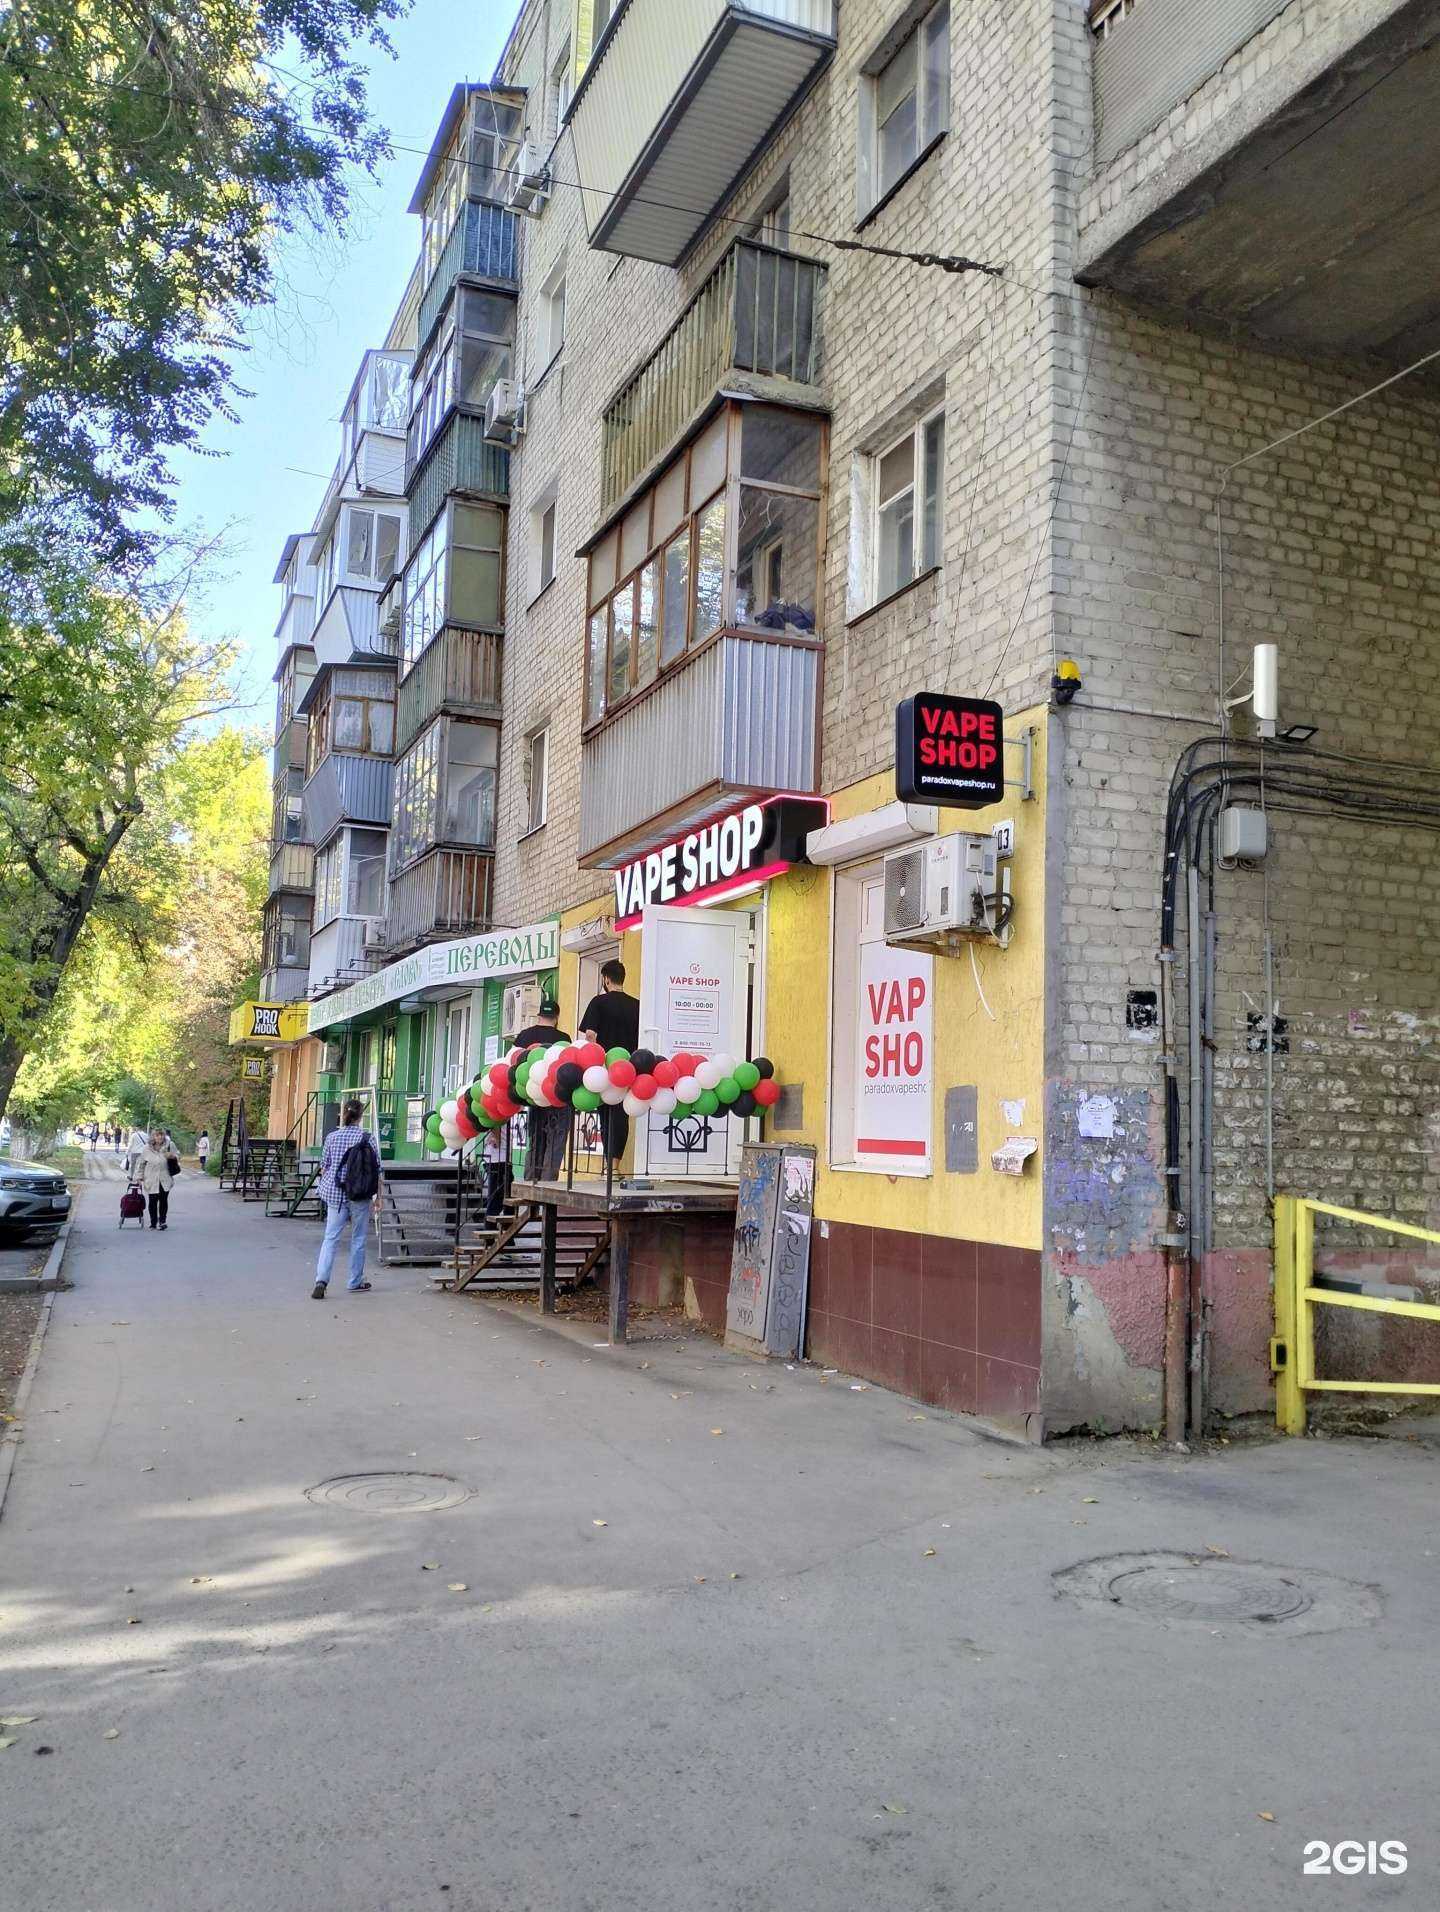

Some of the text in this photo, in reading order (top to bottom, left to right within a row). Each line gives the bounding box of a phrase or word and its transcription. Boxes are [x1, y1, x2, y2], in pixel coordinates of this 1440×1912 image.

[921, 707, 996, 741] VAPE
[920, 737, 997, 770] SHOP
[921, 775, 996, 790] paradoxvapeshop.ru
[615, 804, 763, 918] VAPE SHOP
[447, 930, 556, 975] ПЕРЕВОДЫ
[670, 976, 720, 987] VAPE SHOP
[255, 1009, 278, 1024] PRO
[867, 976, 926, 1025] VAP
[254, 1023, 278, 1035] HOOK
[865, 1031, 923, 1078] SHO
